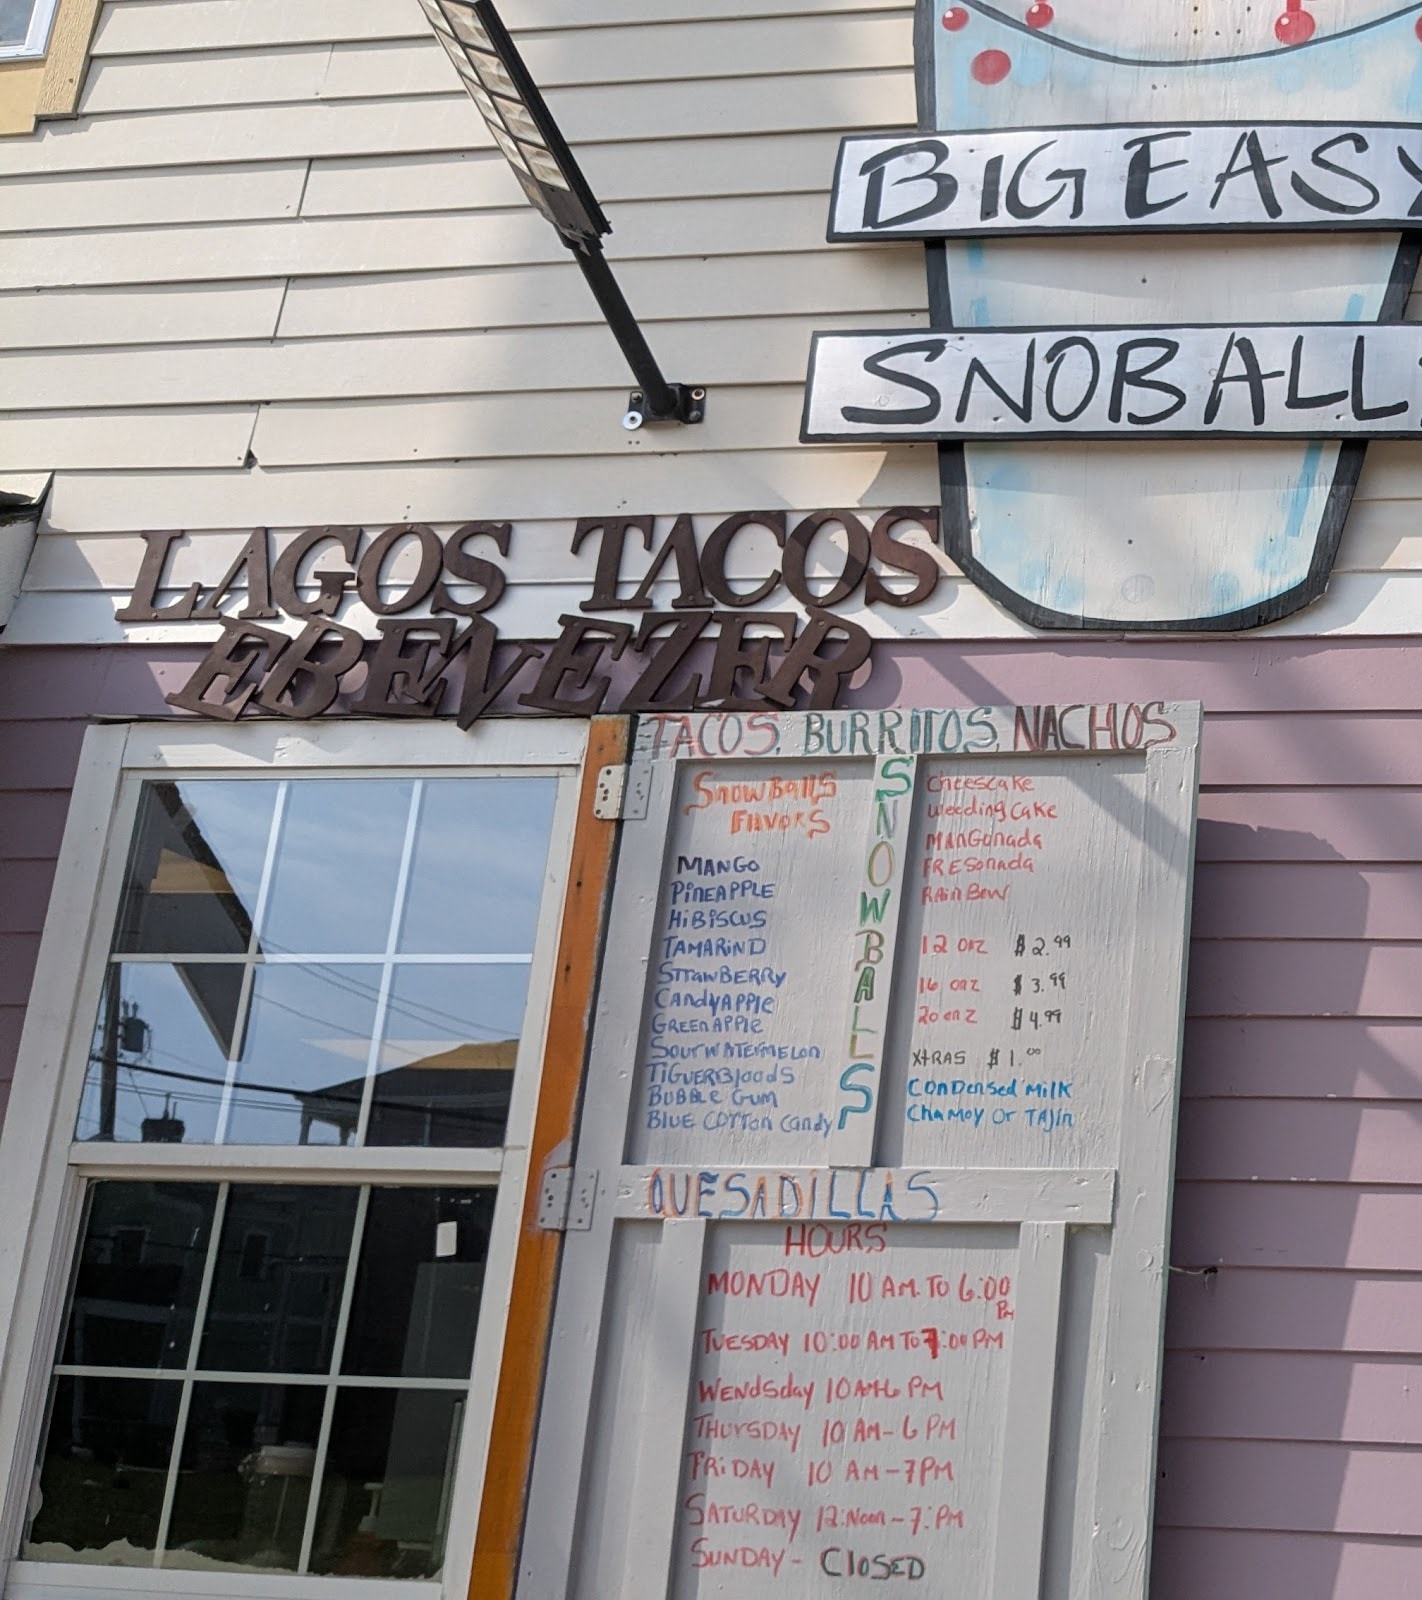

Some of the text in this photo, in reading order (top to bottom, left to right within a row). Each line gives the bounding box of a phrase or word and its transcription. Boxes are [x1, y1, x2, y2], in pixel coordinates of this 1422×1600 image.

[858, 139, 1087, 230] BIG
[115, 506, 941, 622] LAGOS TACOS
[164, 605, 875, 731] EBENEZER
[1013, 702, 1178, 752] NACHOS
[677, 856, 761, 877] MANGO
[922, 934, 948, 955] 12
[919, 976, 939, 994] 16
[784, 1221, 888, 1258] HOURS
[707, 1268, 821, 1307] MONDAY
[849, 1271, 873, 1304] 10
[958, 1272, 1011, 1302] 6:00
[702, 1328, 789, 1356] TUESDAY
[803, 1331, 860, 1353] 10:00
[867, 1331, 895, 1352] AM
[972, 1328, 1004, 1350] PM
[908, 1375, 944, 1401] PM
[822, 1417, 845, 1448] 10
[926, 1413, 956, 1441] PM
[808, 1459, 832, 1487] 10
